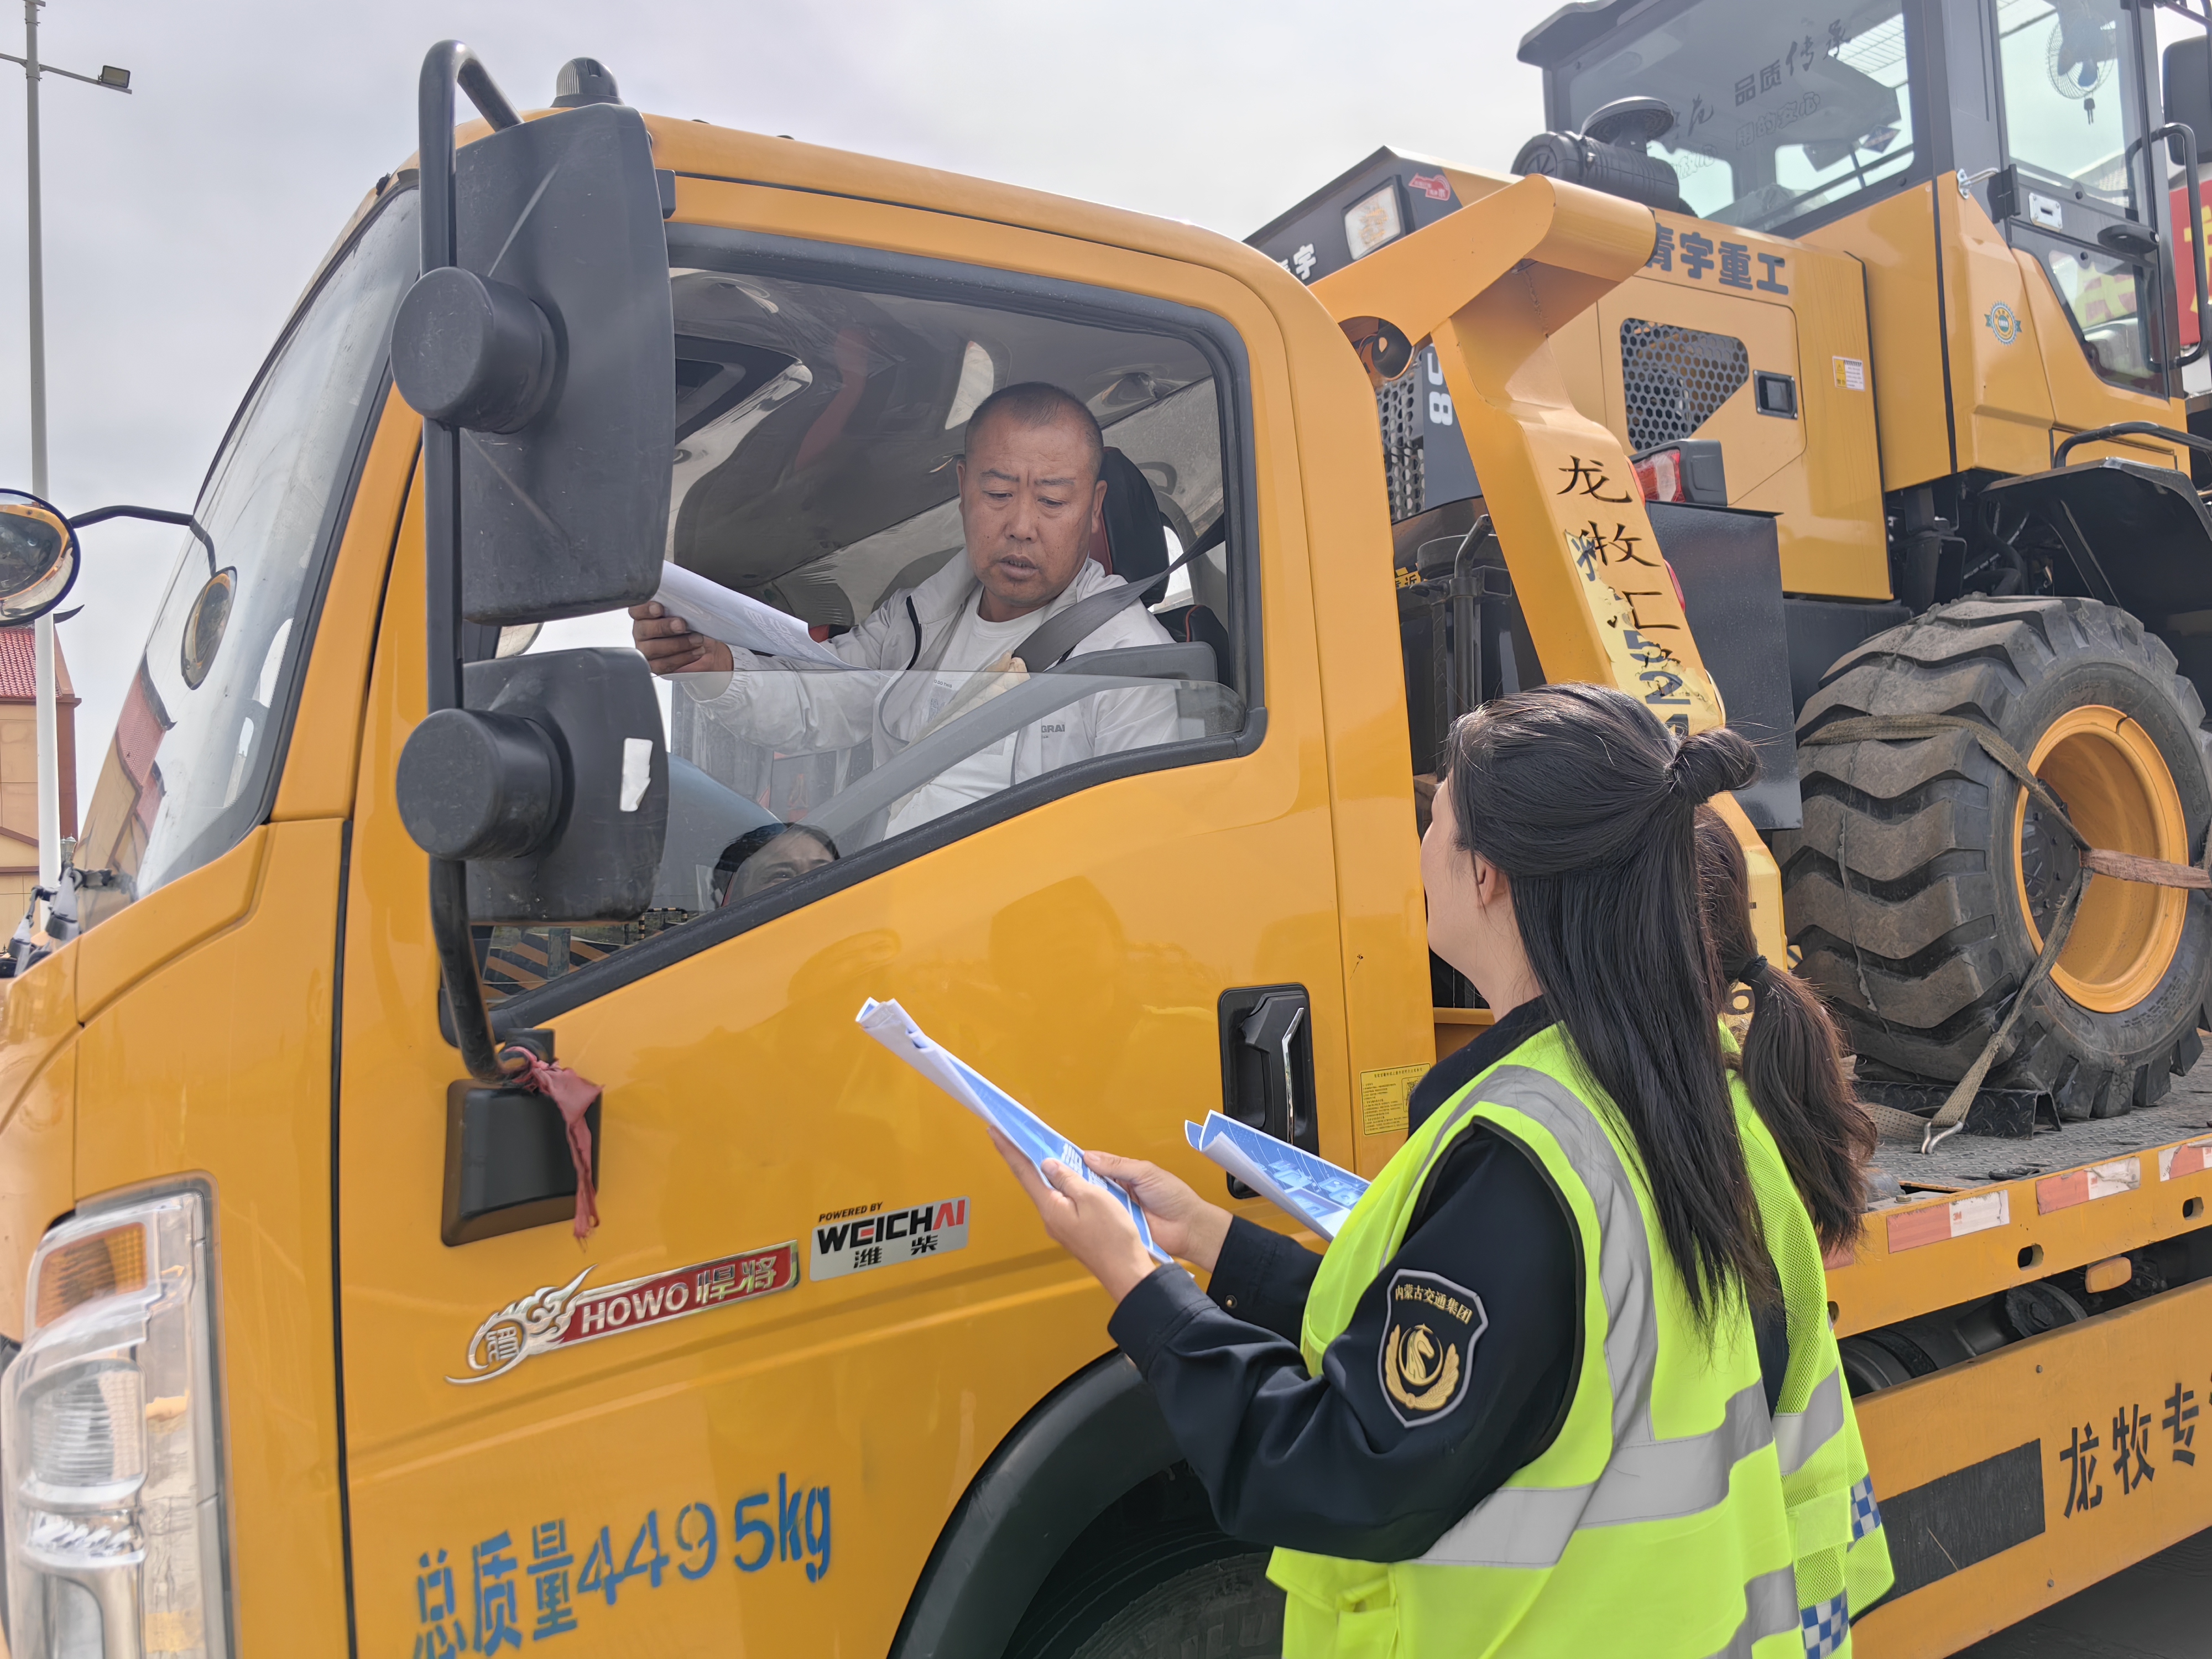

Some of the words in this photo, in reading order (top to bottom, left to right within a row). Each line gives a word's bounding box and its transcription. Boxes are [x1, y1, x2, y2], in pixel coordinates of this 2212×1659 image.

[1735, 19, 1852, 107] 品质传承
[817, 1199, 966, 1255] WEICHAI
[818, 1205, 867, 1222] POWERED
[870, 1202, 883, 1212] BY
[581, 1282, 689, 1334] HOWO
[696, 1256, 776, 1305] 悍将
[1395, 1284, 1473, 1324] 内蒙古交通集团
[2059, 1371, 2212, 1519] 龙牧专
